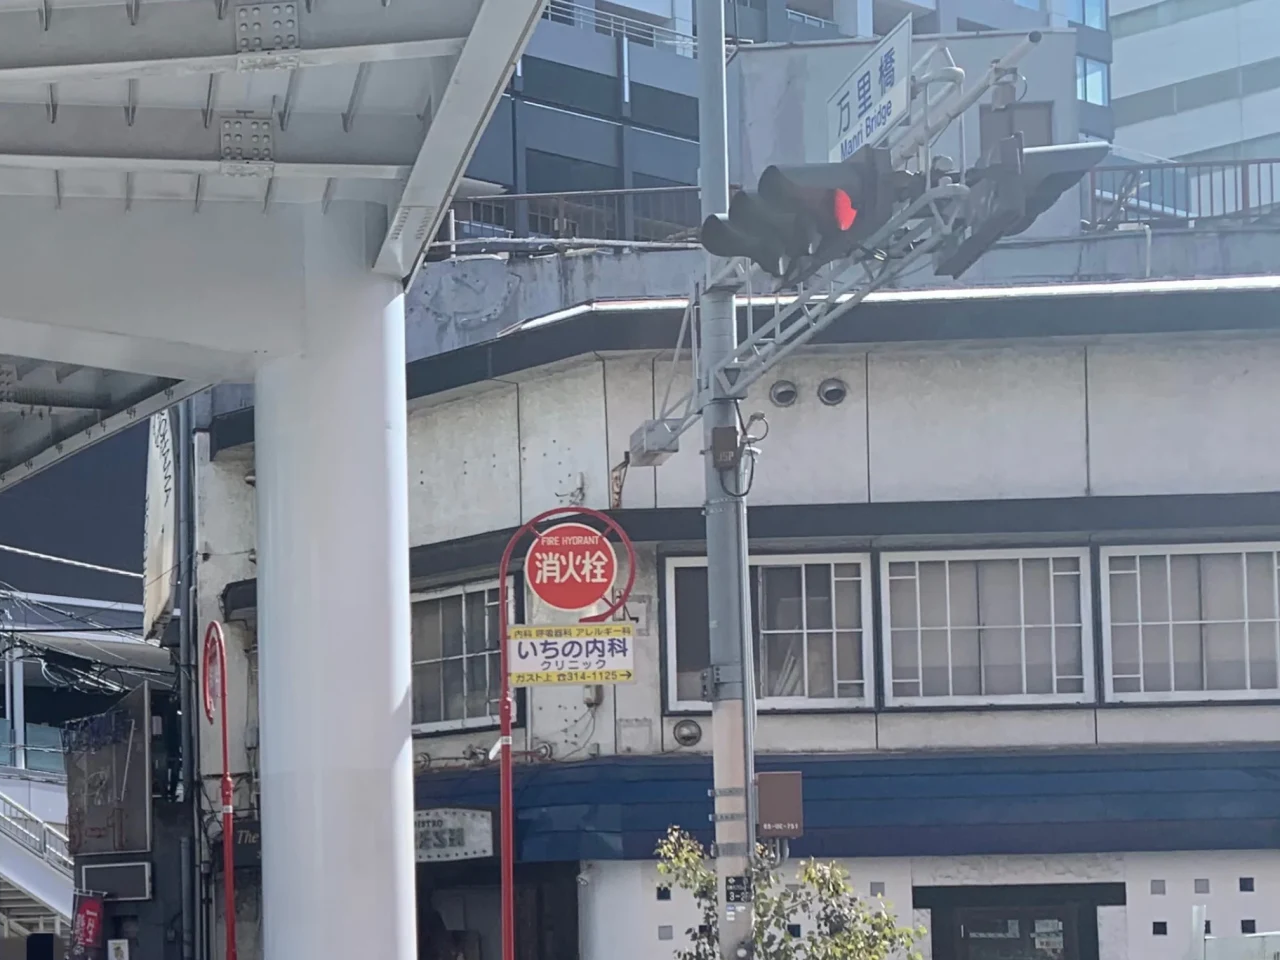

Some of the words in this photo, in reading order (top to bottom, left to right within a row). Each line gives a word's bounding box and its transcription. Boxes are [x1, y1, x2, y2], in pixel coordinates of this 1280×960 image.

[836, 47, 895, 138] 万里橋
[840, 123, 864, 160] Manri
[865, 99, 892, 138] Bridge
[541, 537, 560, 546] FIRE
[562, 536, 600, 546] HYDRANT
[534, 551, 609, 584] 消火栓
[514, 629, 533, 638] 内科
[575, 627, 631, 637] アレルギー科
[517, 638, 629, 660] いちの内科
[540, 659, 607, 671] クリニック
[237, 830, 260, 845] The
